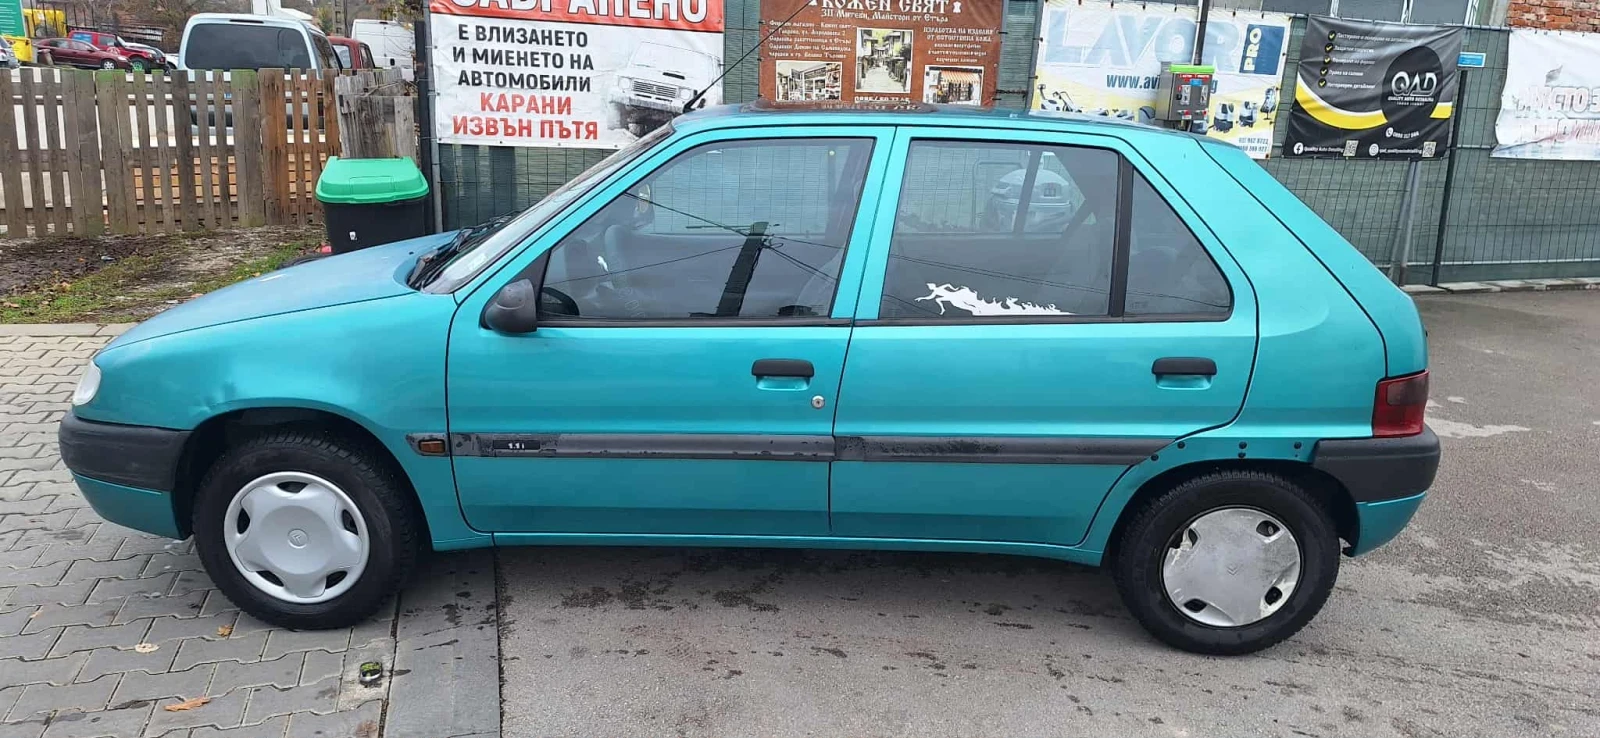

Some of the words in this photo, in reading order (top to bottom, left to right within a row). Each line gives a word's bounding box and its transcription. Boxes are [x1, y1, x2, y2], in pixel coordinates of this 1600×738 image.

[458, 24, 469, 40] Е
[475, 25, 588, 47] ВЛИЗАНЕТО
[1043, 9, 1241, 73] LAVOR
[452, 46, 465, 63] И
[472, 48, 564, 69] МИЕНЕТО
[569, 53, 594, 70] НА
[1243, 27, 1263, 71] PRO
[457, 69, 591, 92] АВТОМОБИЛИ
[1391, 71, 1437, 96] QAD
[480, 92, 572, 115] КАРАНИ
[452, 115, 532, 137] ИЗВЪН
[540, 119, 598, 139] ПЪТЯ
